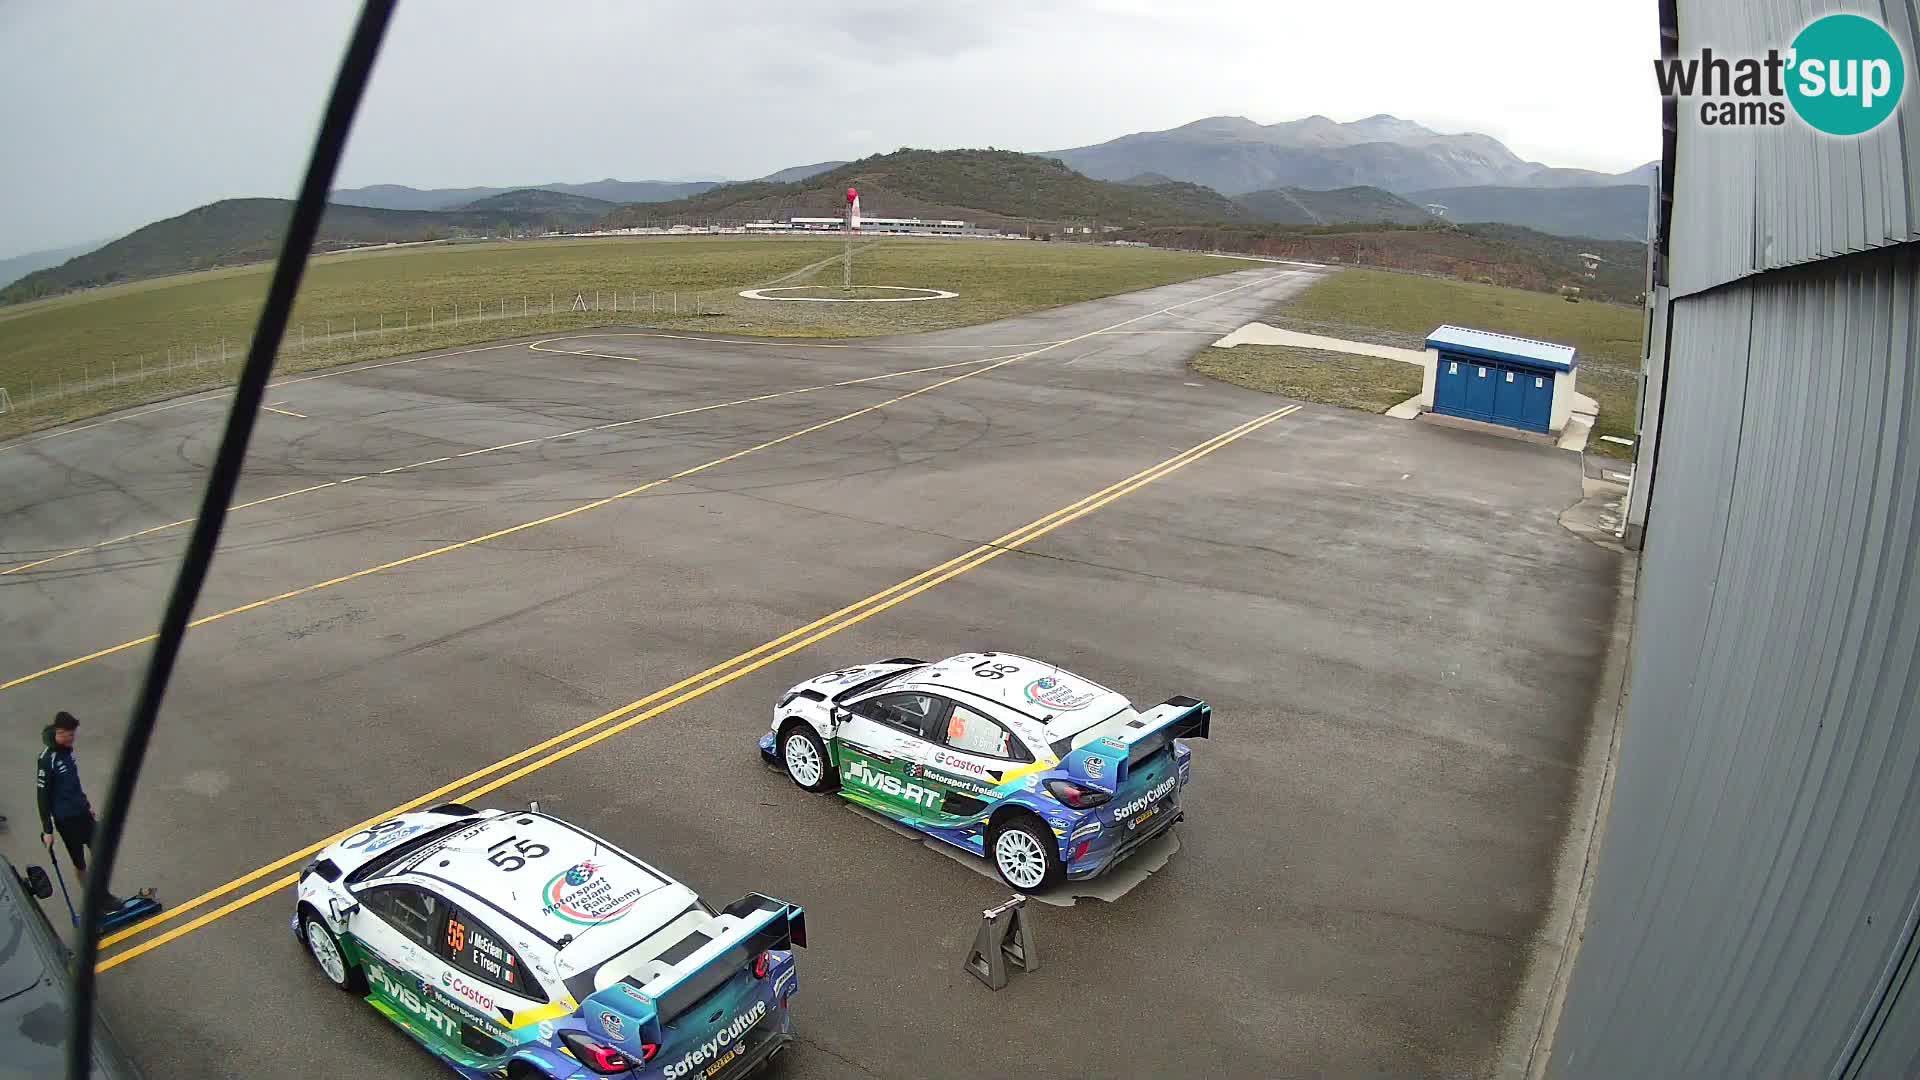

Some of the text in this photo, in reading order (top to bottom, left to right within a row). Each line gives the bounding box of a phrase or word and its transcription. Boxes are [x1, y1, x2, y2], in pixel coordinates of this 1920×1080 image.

[945, 755, 985, 775] Castrol
[861, 768, 941, 808] MS-RT
[923, 769, 970, 791] Motorsport
[971, 784, 1004, 799] Ireland
[1113, 776, 1176, 821] SafetyCulture
[488, 839, 550, 872] 55
[542, 876, 607, 917] Motorsport
[571, 883, 612, 910] Ireland
[583, 893, 612, 913] Rally
[591, 887, 641, 918] Academy
[447, 920, 465, 951] 55
[474, 932, 503, 960] McErlean
[480, 953, 502, 978] Treacy
[382, 979, 457, 1037] MS-RT
[452, 978, 495, 1011] Castrol
[435, 992, 520, 1047] Motorsport Ireland
[663, 1000, 767, 1080] SafetyCulture
